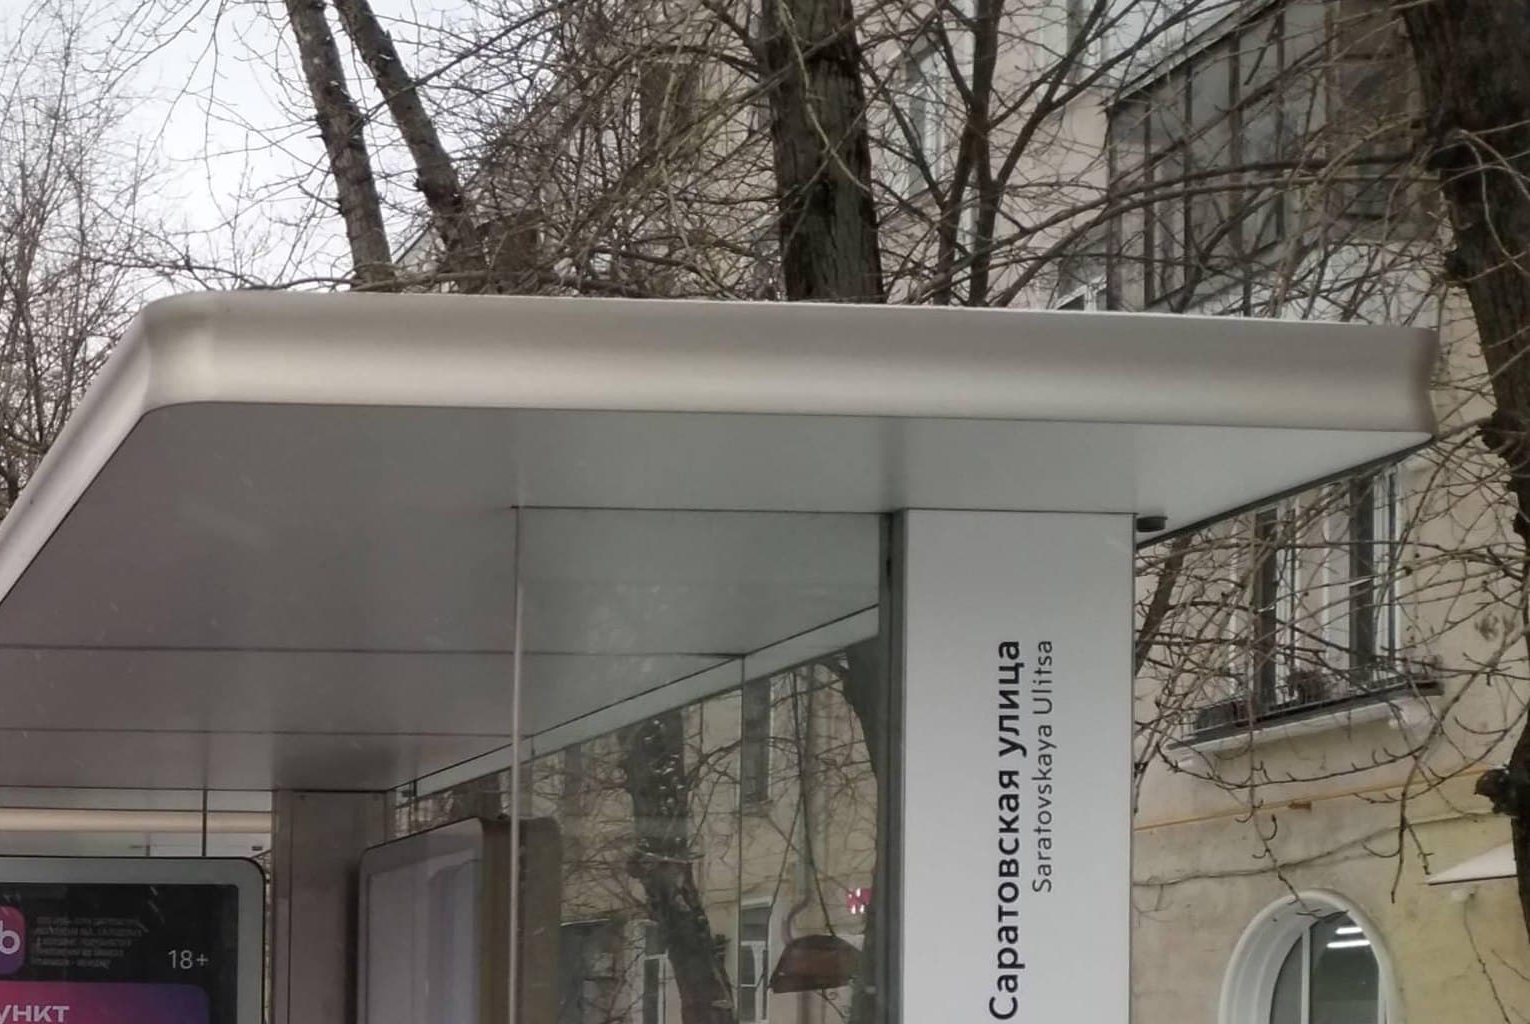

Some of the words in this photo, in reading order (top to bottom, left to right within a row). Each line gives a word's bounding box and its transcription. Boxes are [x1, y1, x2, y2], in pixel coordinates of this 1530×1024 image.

[998, 640, 1027, 758] улица
[1031, 640, 1053, 715] Ulitsa
[1031, 724, 1057, 893] Saratovskaya
[988, 770, 1026, 1021] Саратовская
[167, 949, 209, 970] 18+
